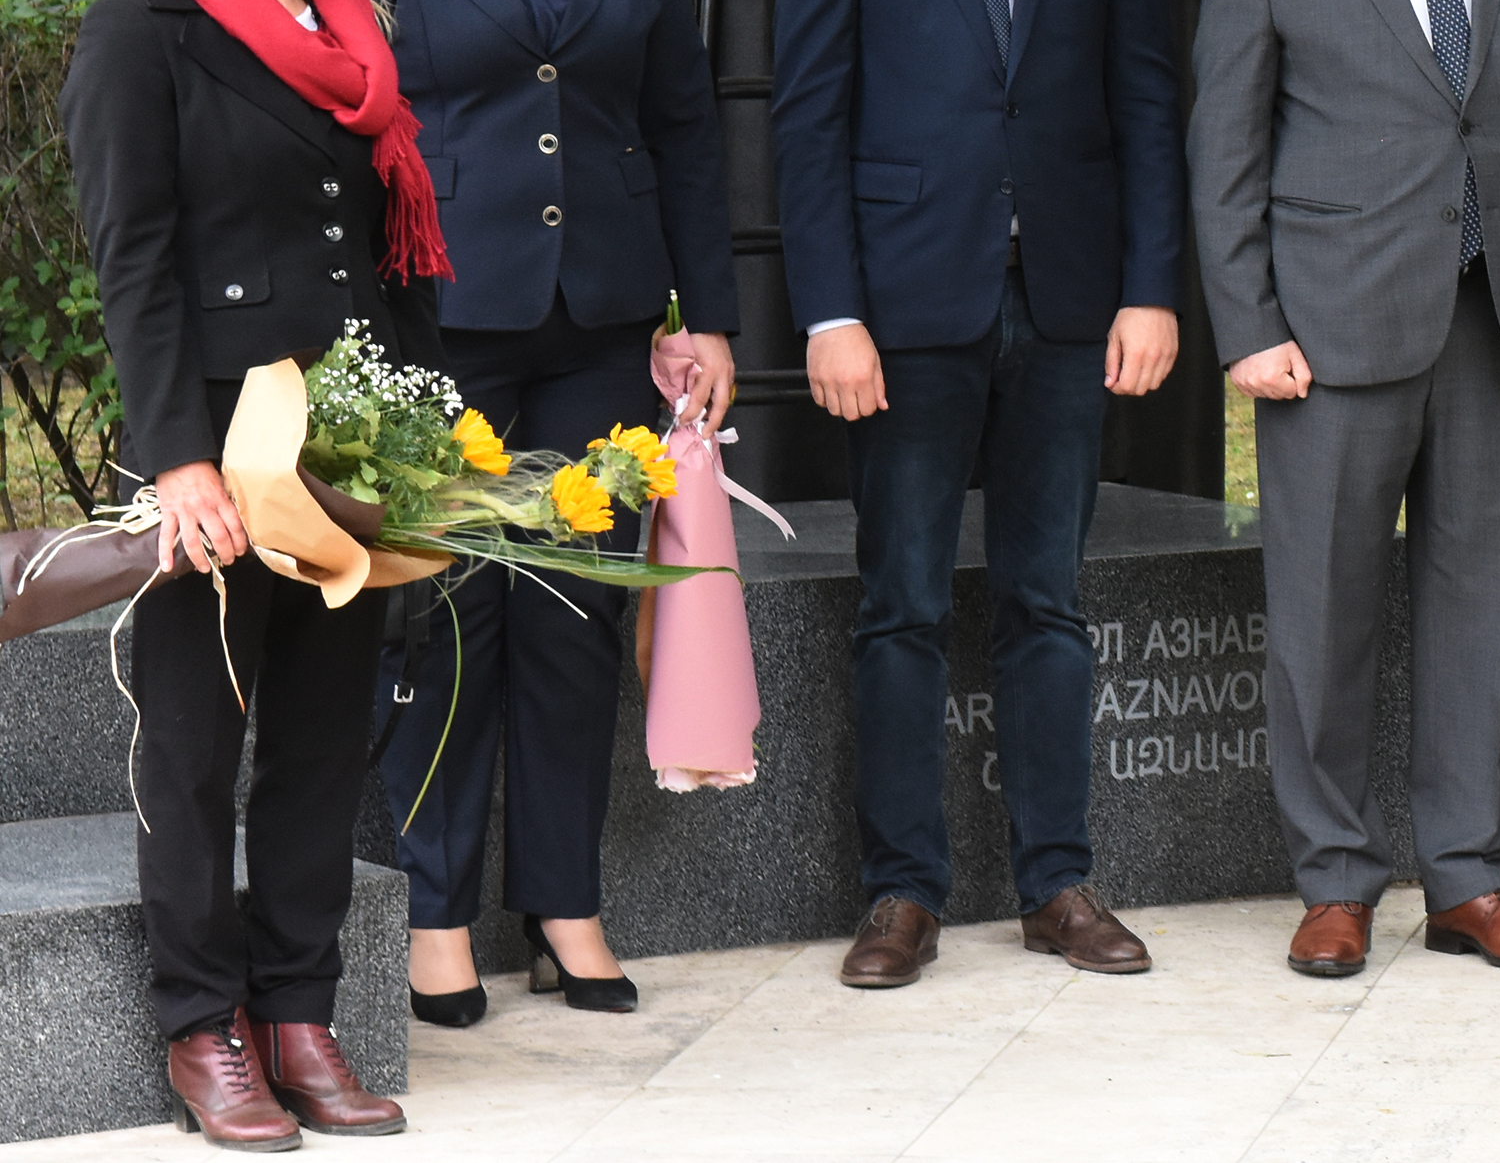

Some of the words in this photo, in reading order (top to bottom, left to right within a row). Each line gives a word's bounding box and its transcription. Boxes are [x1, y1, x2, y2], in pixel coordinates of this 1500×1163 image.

[1143, 612, 1268, 662] АЗНАВ
[945, 693, 996, 734] AR
[1094, 669, 1267, 723] AZNAVO
[1110, 727, 1272, 780] ԱԶՆԱՎՈ
